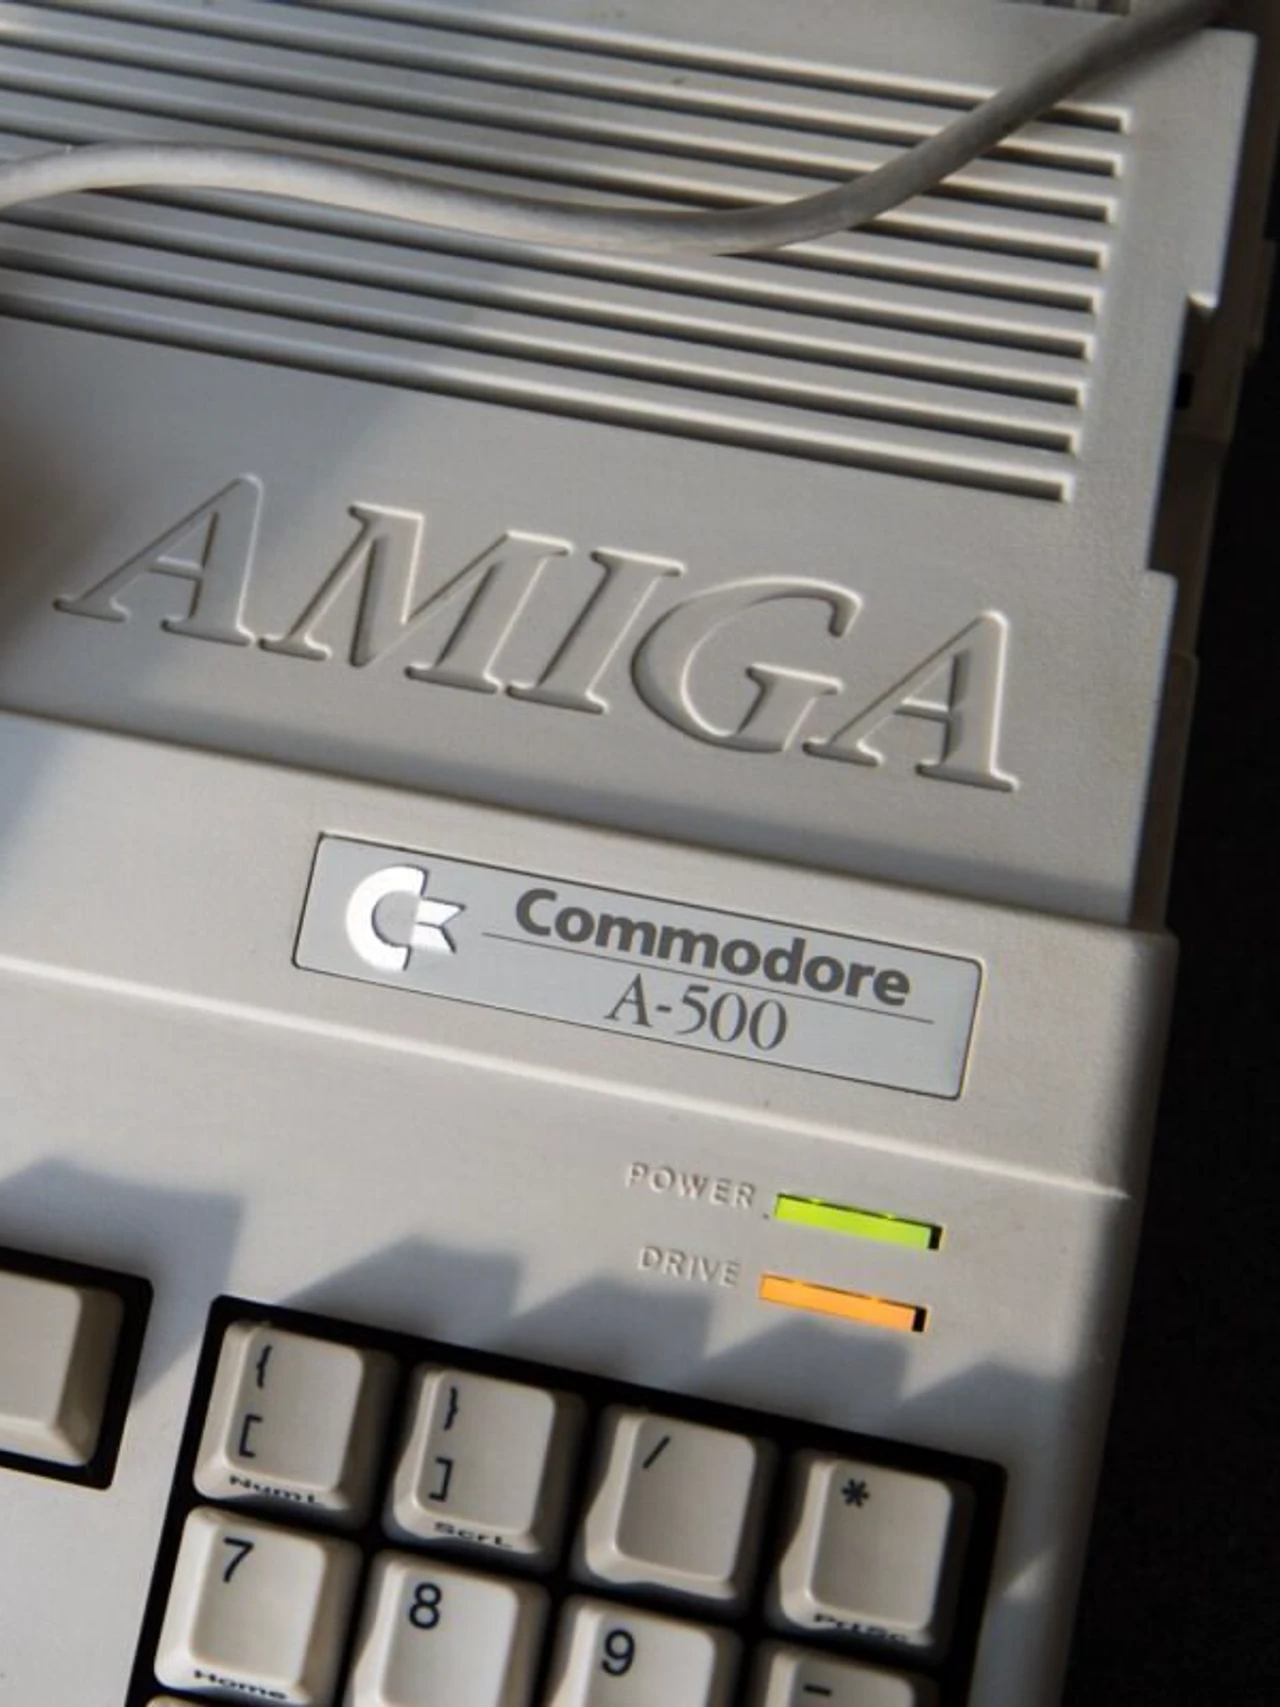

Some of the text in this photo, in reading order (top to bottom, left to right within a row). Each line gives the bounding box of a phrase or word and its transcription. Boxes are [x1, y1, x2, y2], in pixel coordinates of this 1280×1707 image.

[54, 472, 1020, 793] AMIGA
[515, 888, 911, 1007] Commodore
[604, 973, 788, 1052] A-500
[626, 1161, 757, 1208] POWER
[638, 1245, 741, 1288] DRIVE
[223, 1537, 254, 1583] 7
[409, 1582, 442, 1630] 8
[601, 1629, 635, 1676] 9
